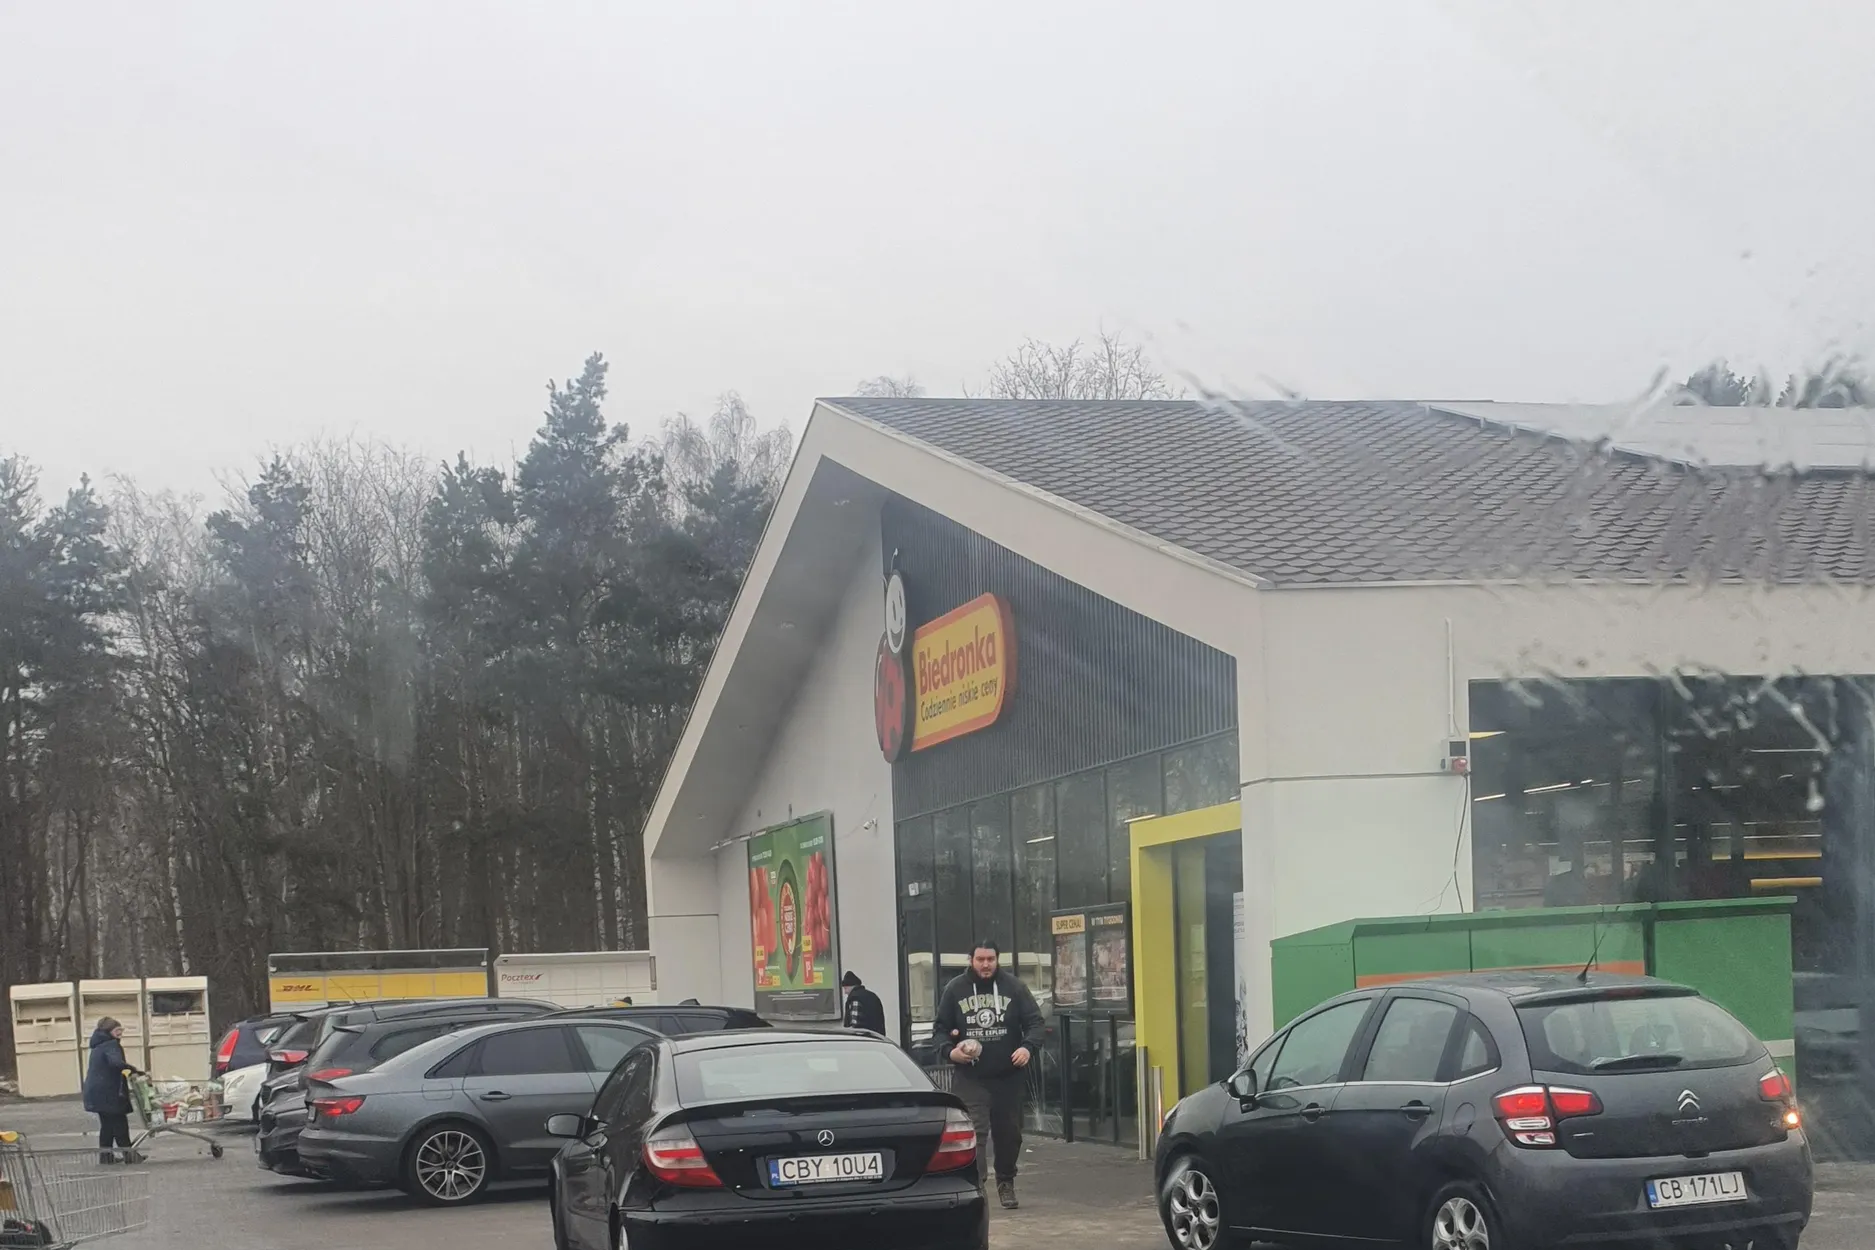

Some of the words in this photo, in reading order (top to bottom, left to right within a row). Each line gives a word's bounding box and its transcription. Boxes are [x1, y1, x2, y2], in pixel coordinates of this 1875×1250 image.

[919, 625, 997, 696] Biedronka
[920, 688, 957, 722] Codziennie
[959, 680, 979, 707] niskie
[981, 677, 998, 698] ceny
[282, 984, 313, 992] DHL
[501, 973, 535, 982] Pocztex
[782, 1158, 823, 1180] CBY
[832, 1155, 879, 1176] 10U4
[1659, 1179, 1683, 1200] CB
[1689, 1174, 1739, 1198] 171LJ
